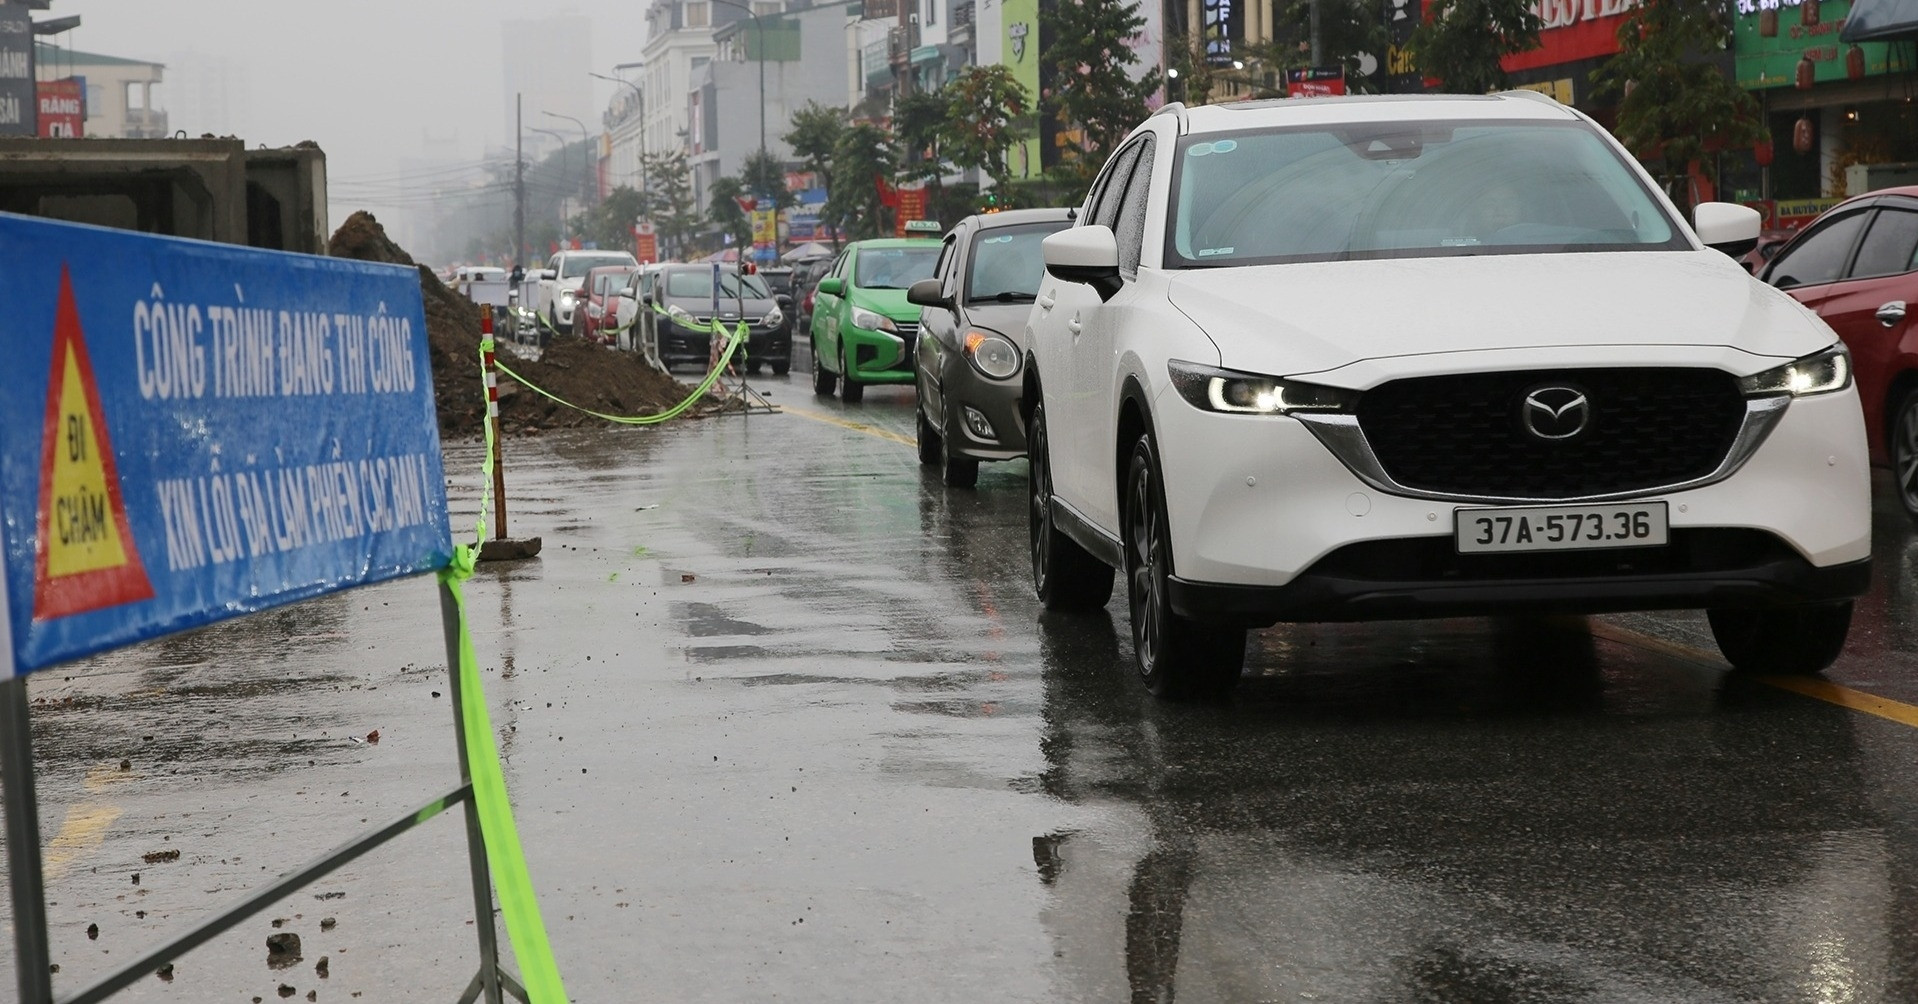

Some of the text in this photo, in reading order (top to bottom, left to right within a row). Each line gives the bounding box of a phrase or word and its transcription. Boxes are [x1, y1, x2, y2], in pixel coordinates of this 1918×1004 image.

[41, 96, 80, 114] RĂNG
[134, 281, 415, 400] CÔNG TRÌNH ĐANG THI CÔNG
[67, 414, 87, 463] ĐI
[56, 484, 108, 554] CHẬM
[157, 477, 206, 572] XIN
[236, 452, 274, 558] ĐÃ
[265, 445, 314, 551] LÀM
[305, 437, 364, 544] PHIỀN
[359, 438, 392, 534] CÁC
[389, 453, 424, 543] BẠN
[1475, 511, 1650, 545] 37A-573.36
